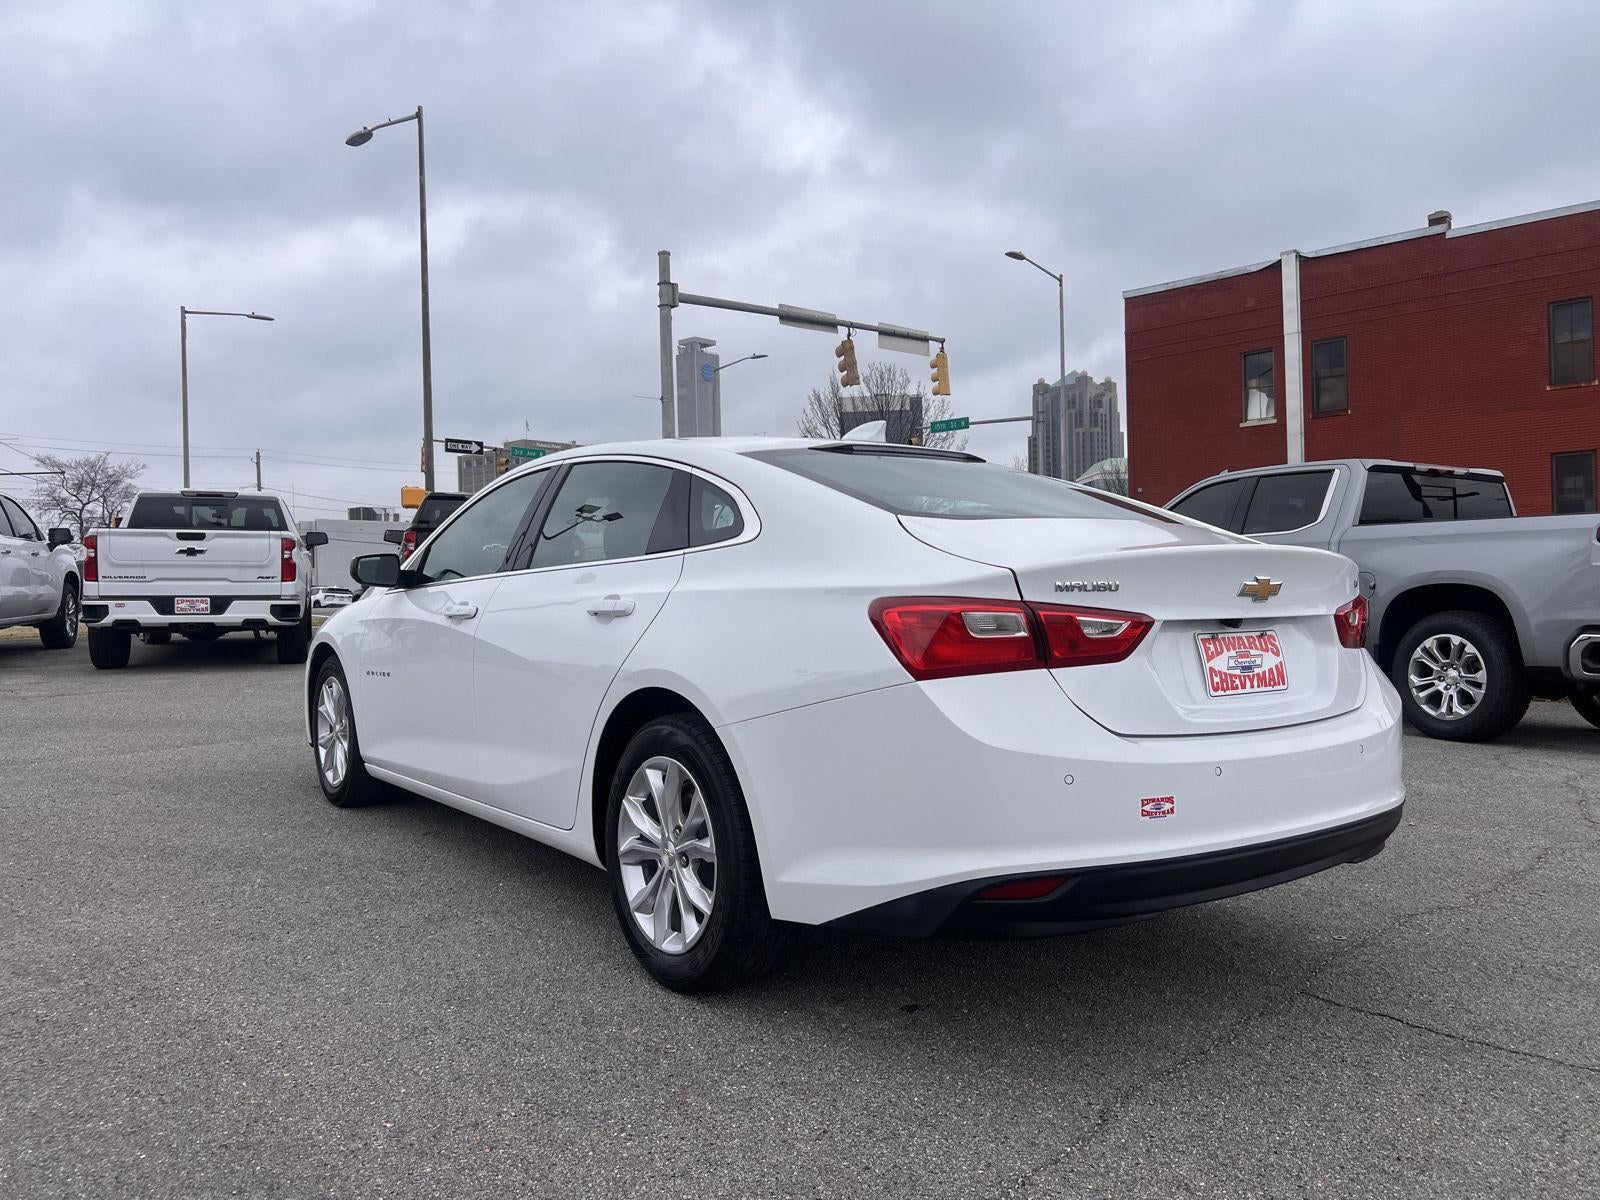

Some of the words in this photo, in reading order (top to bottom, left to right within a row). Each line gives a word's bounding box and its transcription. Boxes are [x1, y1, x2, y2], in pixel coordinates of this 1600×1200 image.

[1055, 581, 1120, 592] MALIBU
[1200, 634, 1281, 663] EDWARDS
[1233, 658, 1257, 666] Chevrolet
[1208, 660, 1286, 692] CHEVYMAN
[1141, 796, 1174, 808] EDWARDS
